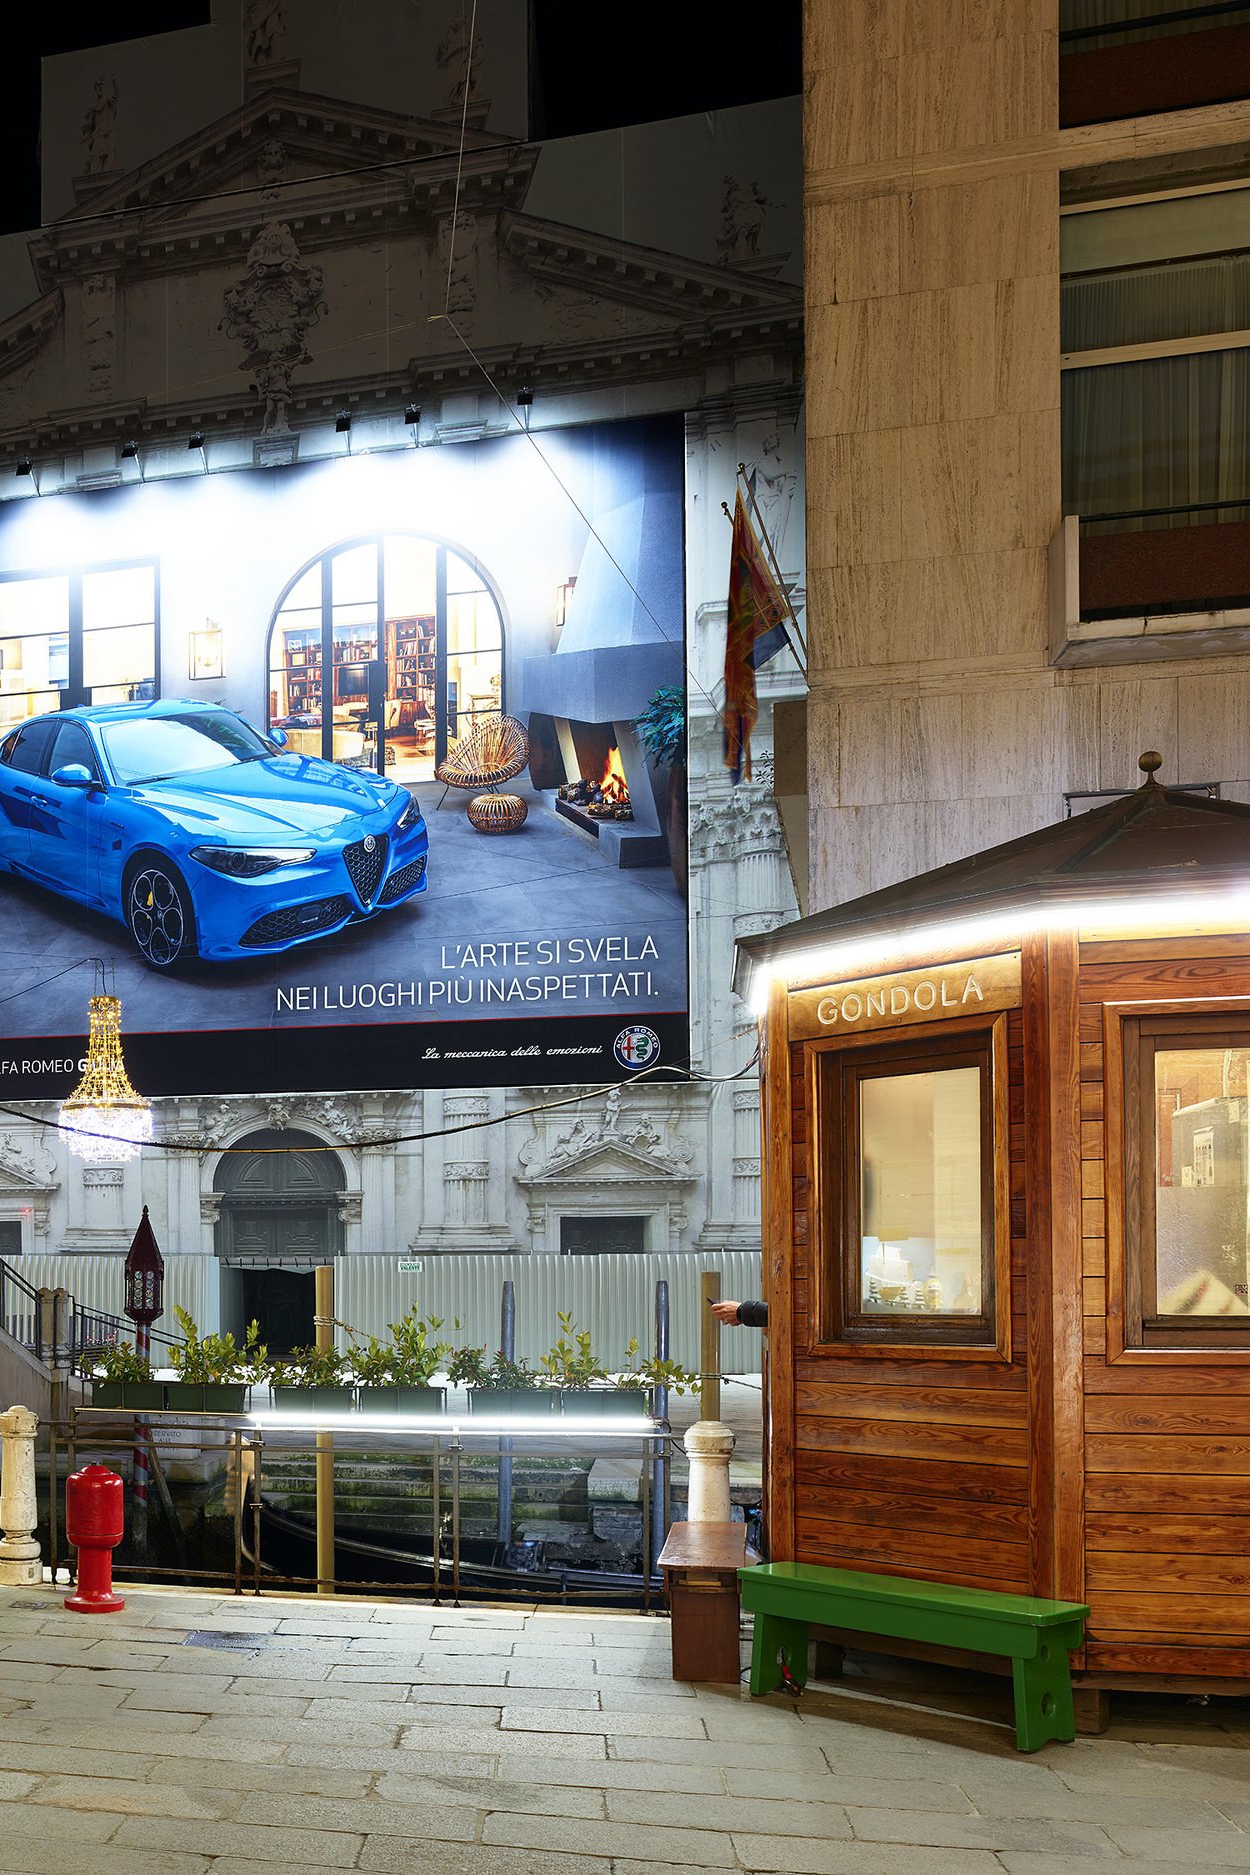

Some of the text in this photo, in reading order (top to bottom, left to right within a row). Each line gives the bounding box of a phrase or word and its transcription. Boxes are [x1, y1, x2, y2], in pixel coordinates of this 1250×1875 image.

[441, 935, 660, 969] L'ARTE SI SVELA
[276, 971, 659, 1011] NEI LUOGHI PIÙ INASPETTATI.
[817, 973, 985, 1025] GONDOLA
[616, 1027, 659, 1049] ALFA ROMEO
[21, 1058, 75, 1075] ROMEO
[421, 1045, 603, 1060] La meccanica delle emozioni
